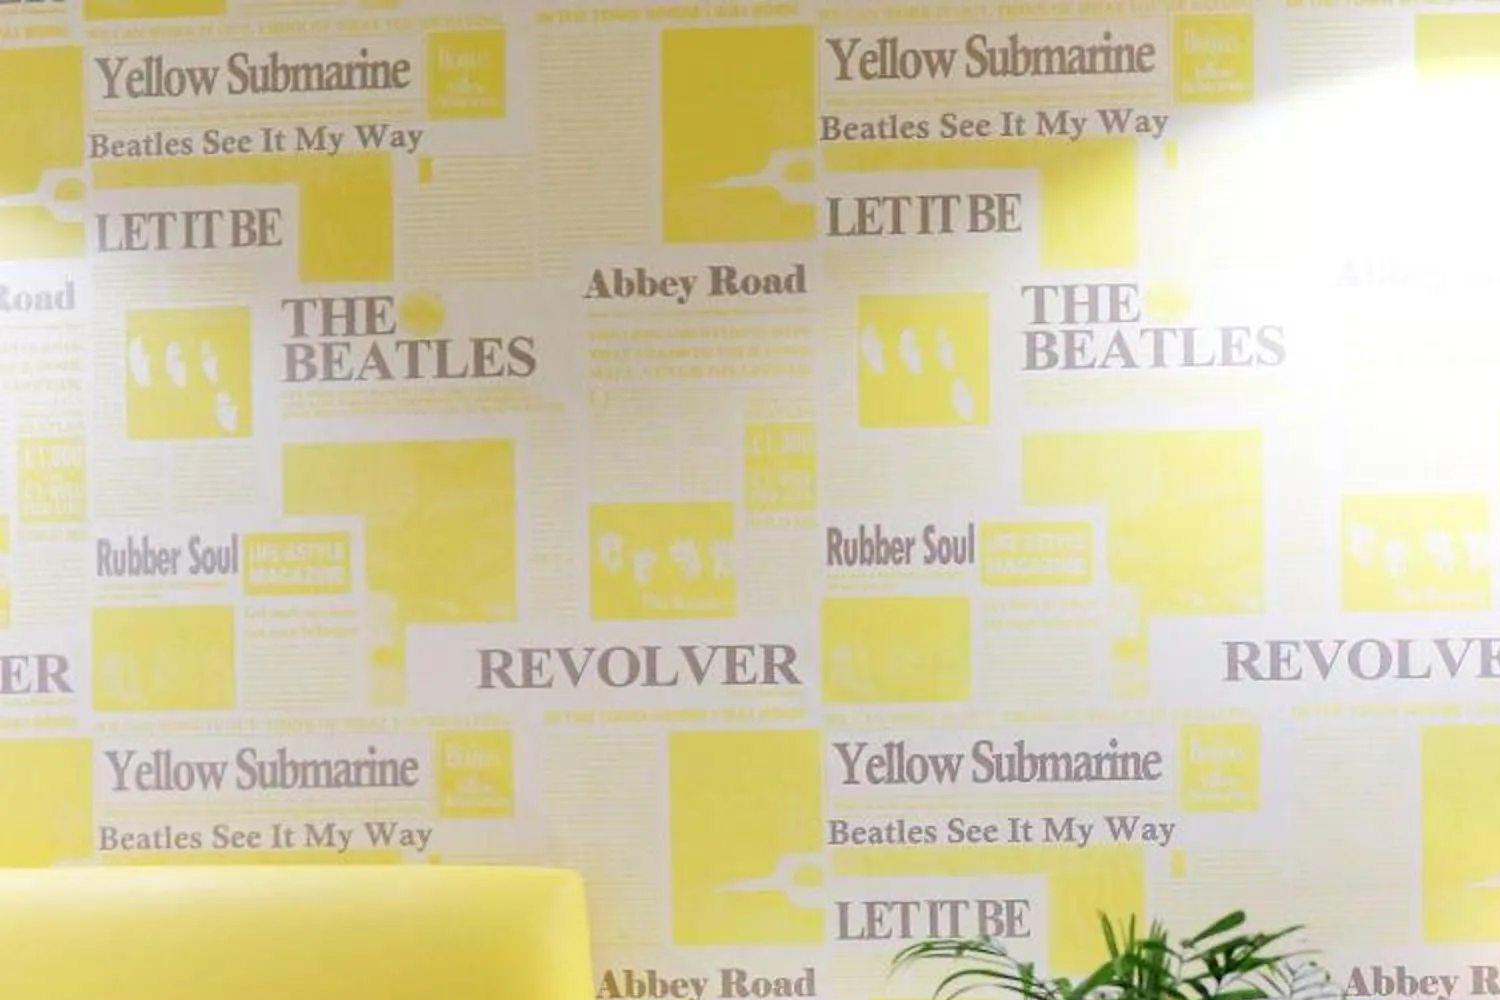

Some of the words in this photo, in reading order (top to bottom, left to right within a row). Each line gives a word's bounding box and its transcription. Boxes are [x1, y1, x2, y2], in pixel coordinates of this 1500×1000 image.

[94, 54, 220, 99] Yellow
[227, 48, 411, 95] Submarine
[825, 36, 958, 81] Yellow
[965, 31, 1156, 78] Submarine
[89, 131, 193, 158] Beatles
[203, 129, 253, 155] See
[260, 128, 286, 152] It
[295, 125, 345, 157] My
[353, 124, 423, 154] Way
[819, 114, 930, 141] Beatles
[939, 112, 992, 138] See
[1000, 112, 1026, 136] It
[1036, 110, 1088, 142] My
[1096, 108, 1168, 140] Way
[95, 211, 177, 252] LET
[181, 210, 224, 249] IT
[229, 208, 282, 247] BE
[826, 196, 912, 237] LET
[916, 194, 961, 234] IT
[966, 193, 1022, 233] BE
[582, 267, 698, 305] Abbey
[708, 264, 807, 296] Road
[1021, 283, 1141, 325] THE
[281, 295, 397, 338] THE
[282, 336, 536, 382] BEATLES
[1022, 326, 1284, 370] BEATLES
[97, 534, 182, 577] Rubber
[188, 533, 238, 575] Soul
[827, 524, 916, 567] Rubber
[922, 522, 974, 565] Soul
[477, 644, 802, 689] REVOLVER
[104, 749, 228, 792] Yellow
[236, 745, 419, 791] Submarine
[832, 741, 965, 785] Yellow
[972, 738, 1162, 783] Submarine
[99, 825, 203, 851] Beatles
[212, 824, 261, 849] See
[271, 824, 295, 849] It
[304, 822, 353, 854] My
[364, 822, 432, 853] Way
[827, 819, 937, 845] Beatles
[948, 818, 999, 844] See
[1008, 818, 1033, 843] It
[1042, 817, 1094, 848] My
[1104, 816, 1176, 847] Way
[835, 901, 921, 940] LET
[925, 900, 969, 938] IT
[975, 899, 1031, 938] BE
[718, 967, 816, 998] Road
